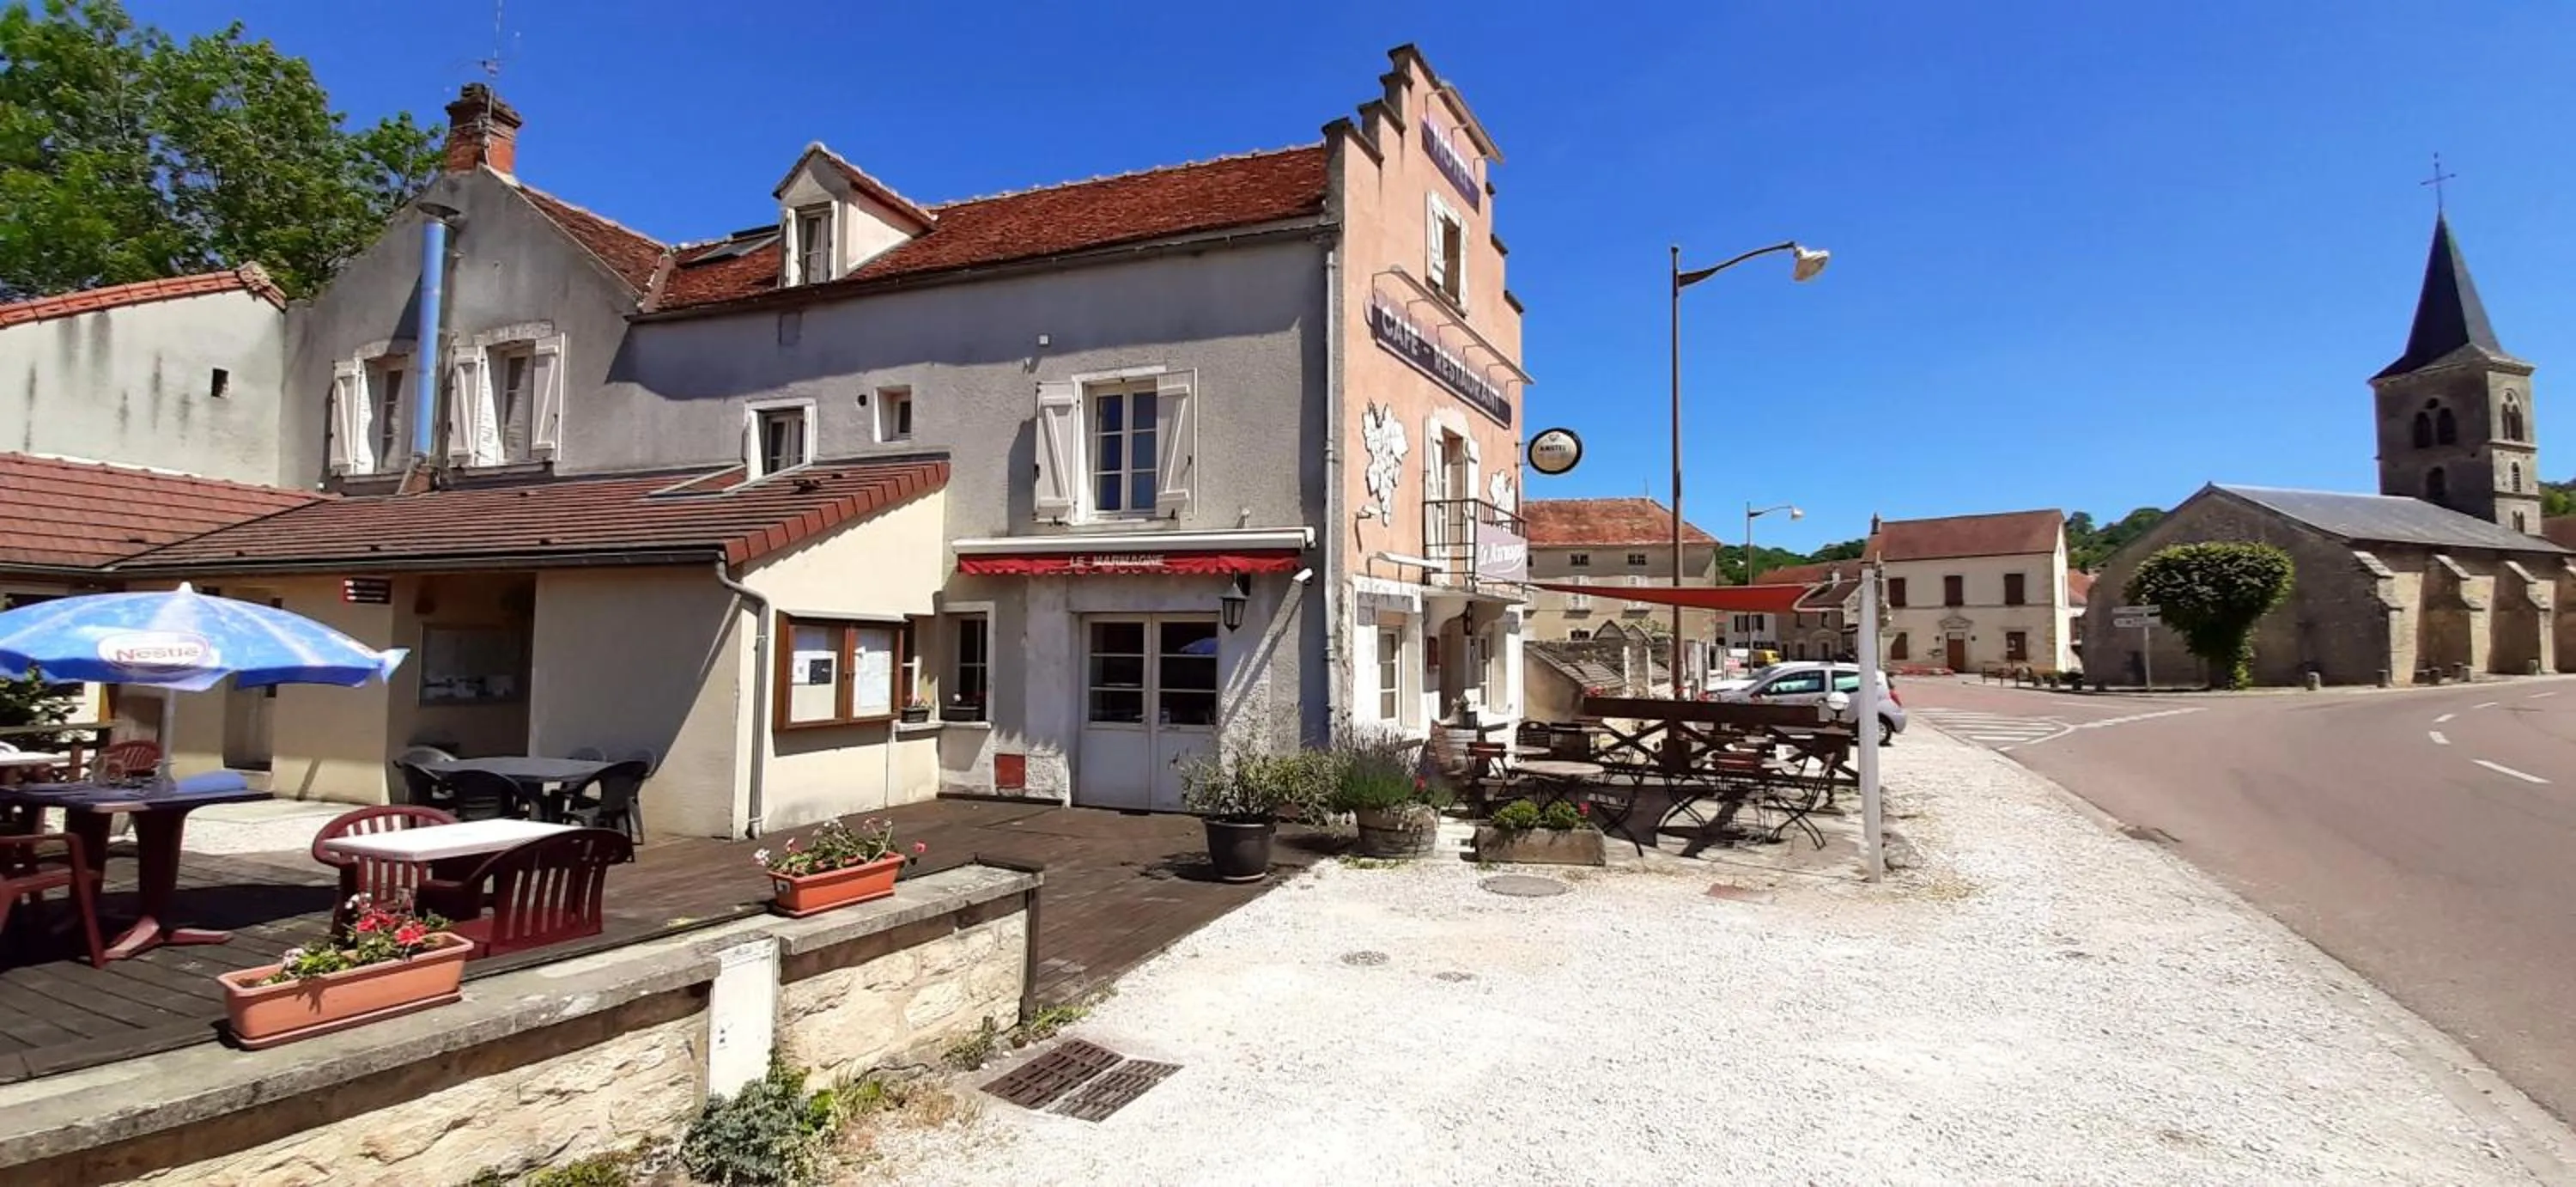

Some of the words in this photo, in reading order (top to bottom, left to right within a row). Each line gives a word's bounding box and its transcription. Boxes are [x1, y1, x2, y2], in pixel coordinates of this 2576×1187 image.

[1432, 123, 1470, 192] HOTEL
[1434, 344, 1501, 414] RESTAURANT
[1069, 556, 1086, 567] LE
[1093, 554, 1165, 567] MARMAGNE
